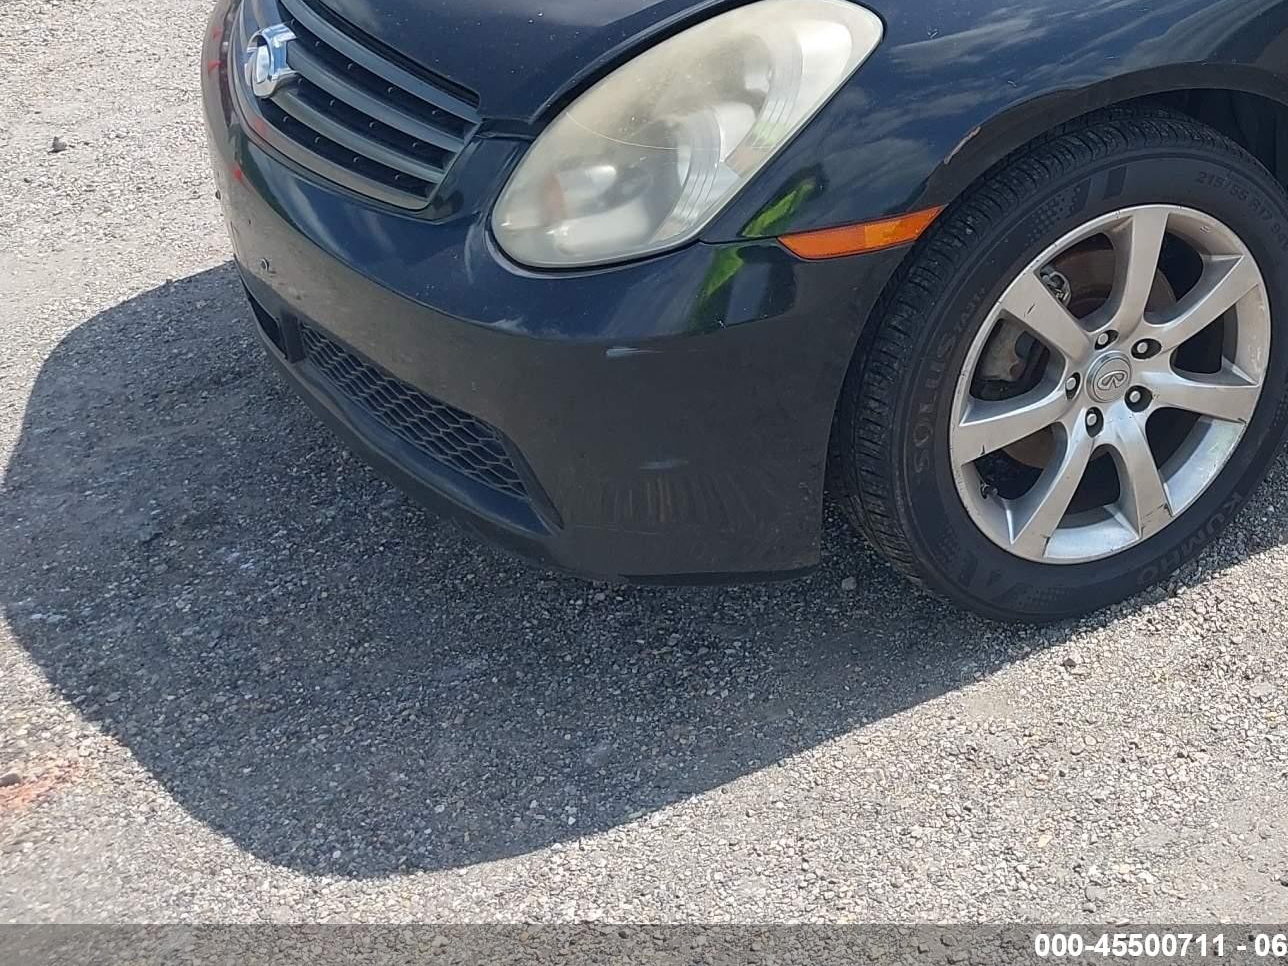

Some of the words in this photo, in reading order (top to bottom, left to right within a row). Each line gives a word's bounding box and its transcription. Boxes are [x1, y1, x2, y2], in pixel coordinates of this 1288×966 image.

[1195, 170, 1250, 201] 215/55
[912, 332, 957, 474] SOLUS
[1137, 492, 1243, 586] KUMHO
